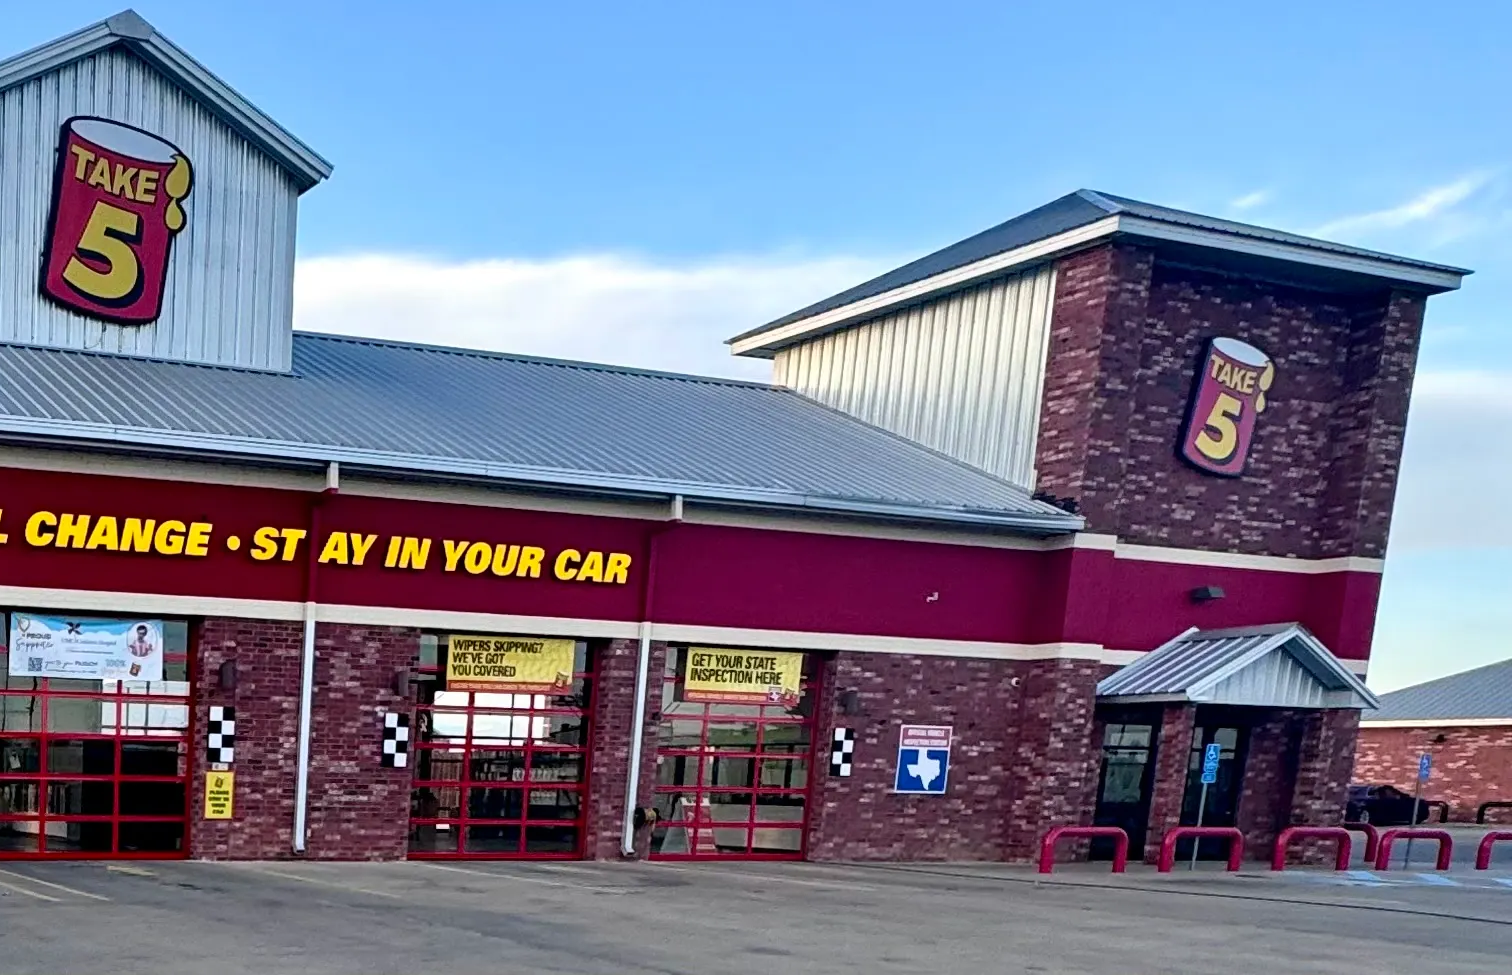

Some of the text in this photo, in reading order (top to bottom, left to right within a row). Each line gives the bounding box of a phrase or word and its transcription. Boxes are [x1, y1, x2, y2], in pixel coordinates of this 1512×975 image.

[71, 144, 159, 203] TAKE
[62, 201, 140, 301] 5
[1211, 354, 1257, 394] TAKE
[1194, 392, 1242, 460] 5
[25, 511, 213, 556] CHANGE
[384, 536, 431, 569] IN
[443, 539, 545, 578] YOUR
[554, 548, 632, 584] CAR
[452, 652, 506, 665] WE'VE GOT
[453, 639, 544, 653] WIPERS SKIPPING?
[451, 664, 516, 677] YOU COVERED
[692, 653, 777, 670] GET YOUR STATE
[690, 668, 783, 685] INSPECTION HERE
